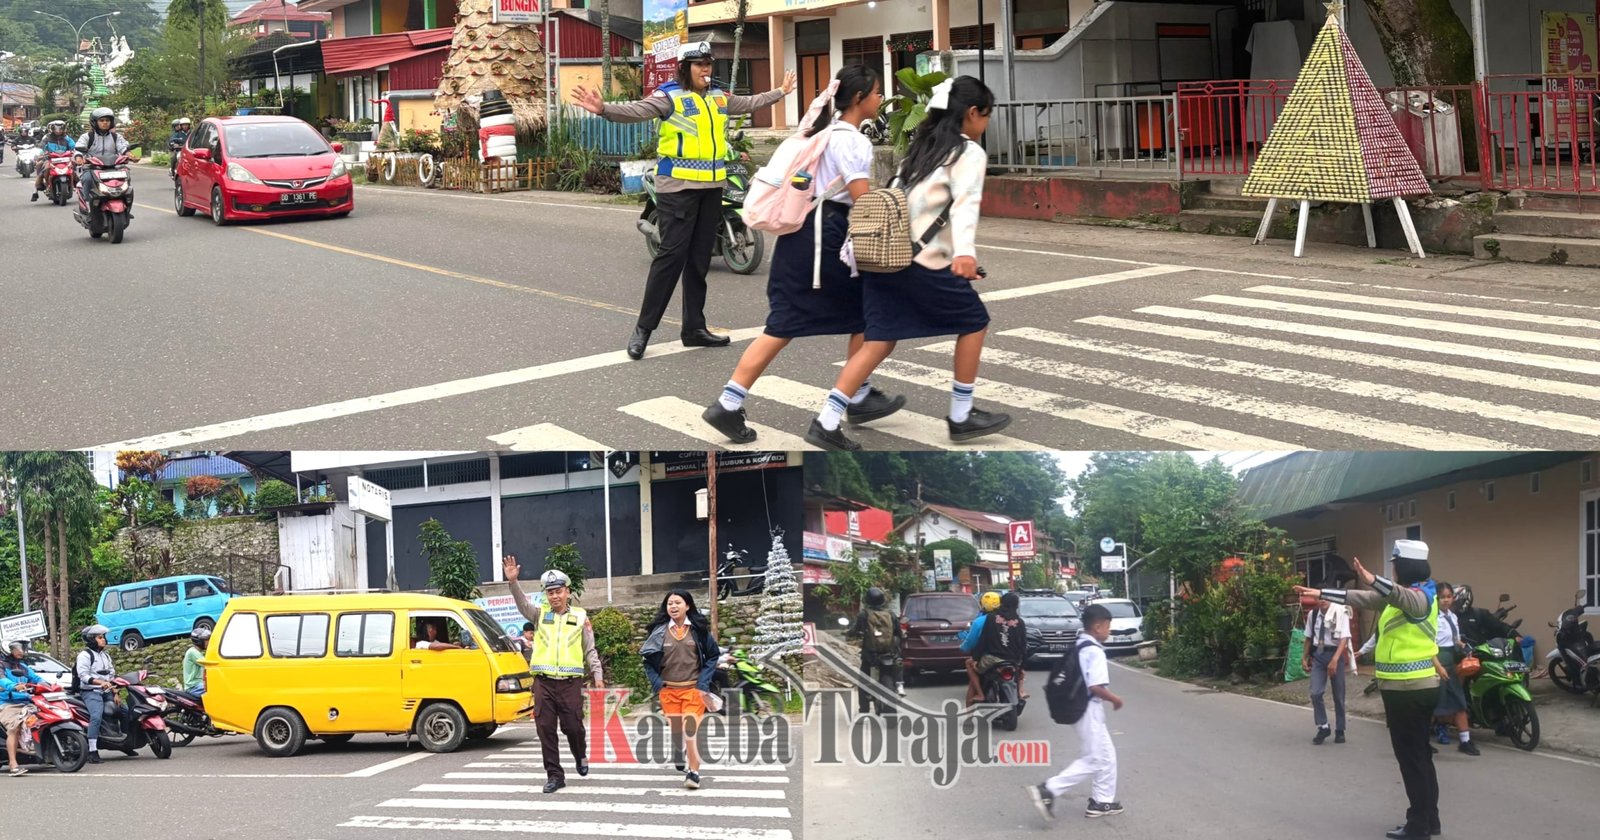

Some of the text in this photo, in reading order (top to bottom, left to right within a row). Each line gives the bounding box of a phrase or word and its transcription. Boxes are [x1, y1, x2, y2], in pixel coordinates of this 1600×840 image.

[500, 0, 539, 12] BUNGIN
[1547, 78, 1558, 92] 18
[720, 459, 745, 467] BUBUK
[362, 481, 387, 499] NOTARIS
[488, 596, 519, 606] PERHATI
